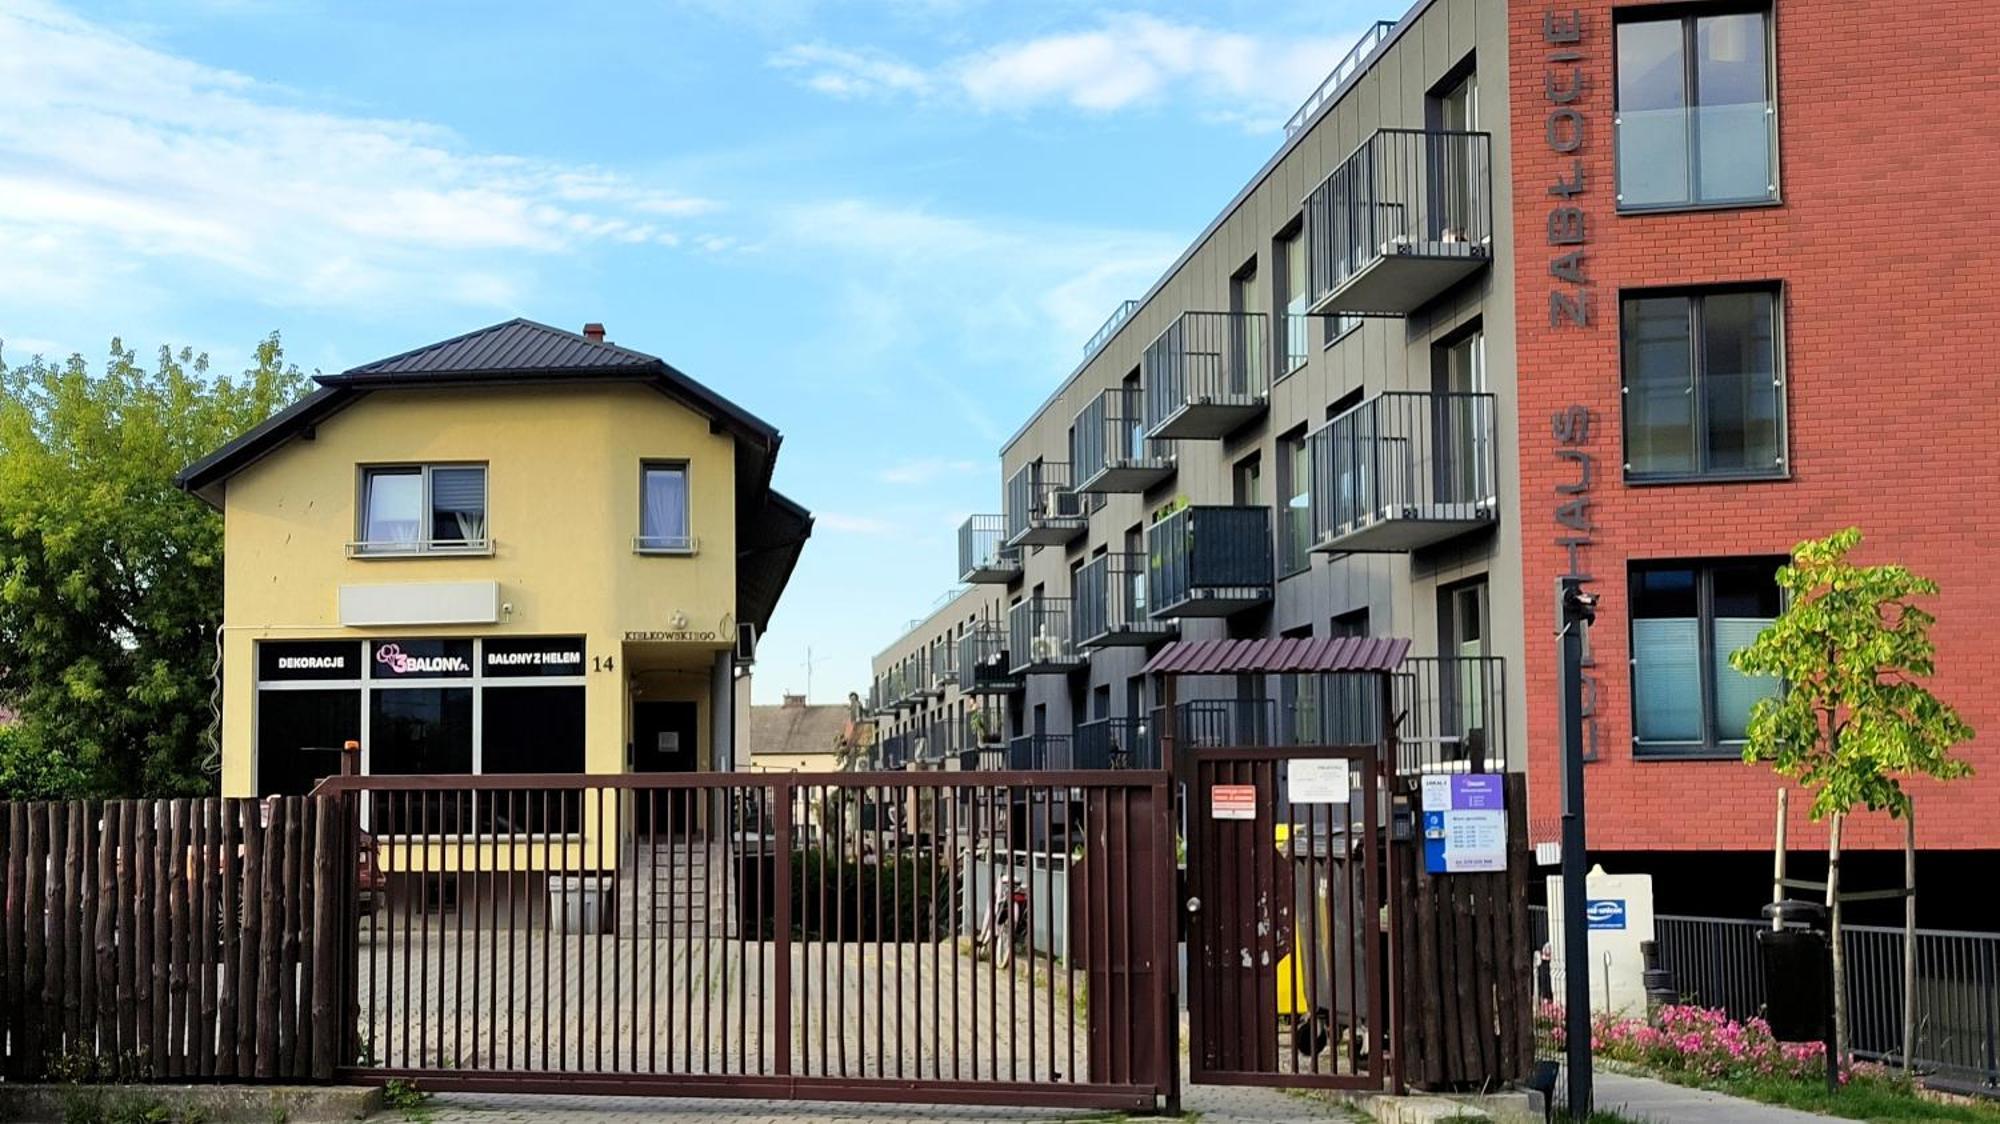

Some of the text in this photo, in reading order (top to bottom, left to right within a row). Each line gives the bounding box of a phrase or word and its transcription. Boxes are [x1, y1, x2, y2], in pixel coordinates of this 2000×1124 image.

[1544, 8, 1588, 329] ZABŁOCIE
[624, 631, 716, 641] KIEŁKOWSKIEGO
[278, 657, 345, 669] DEKORACJE
[488, 652, 581, 665] BALONY Z HELEM
[592, 655, 614, 673] 14
